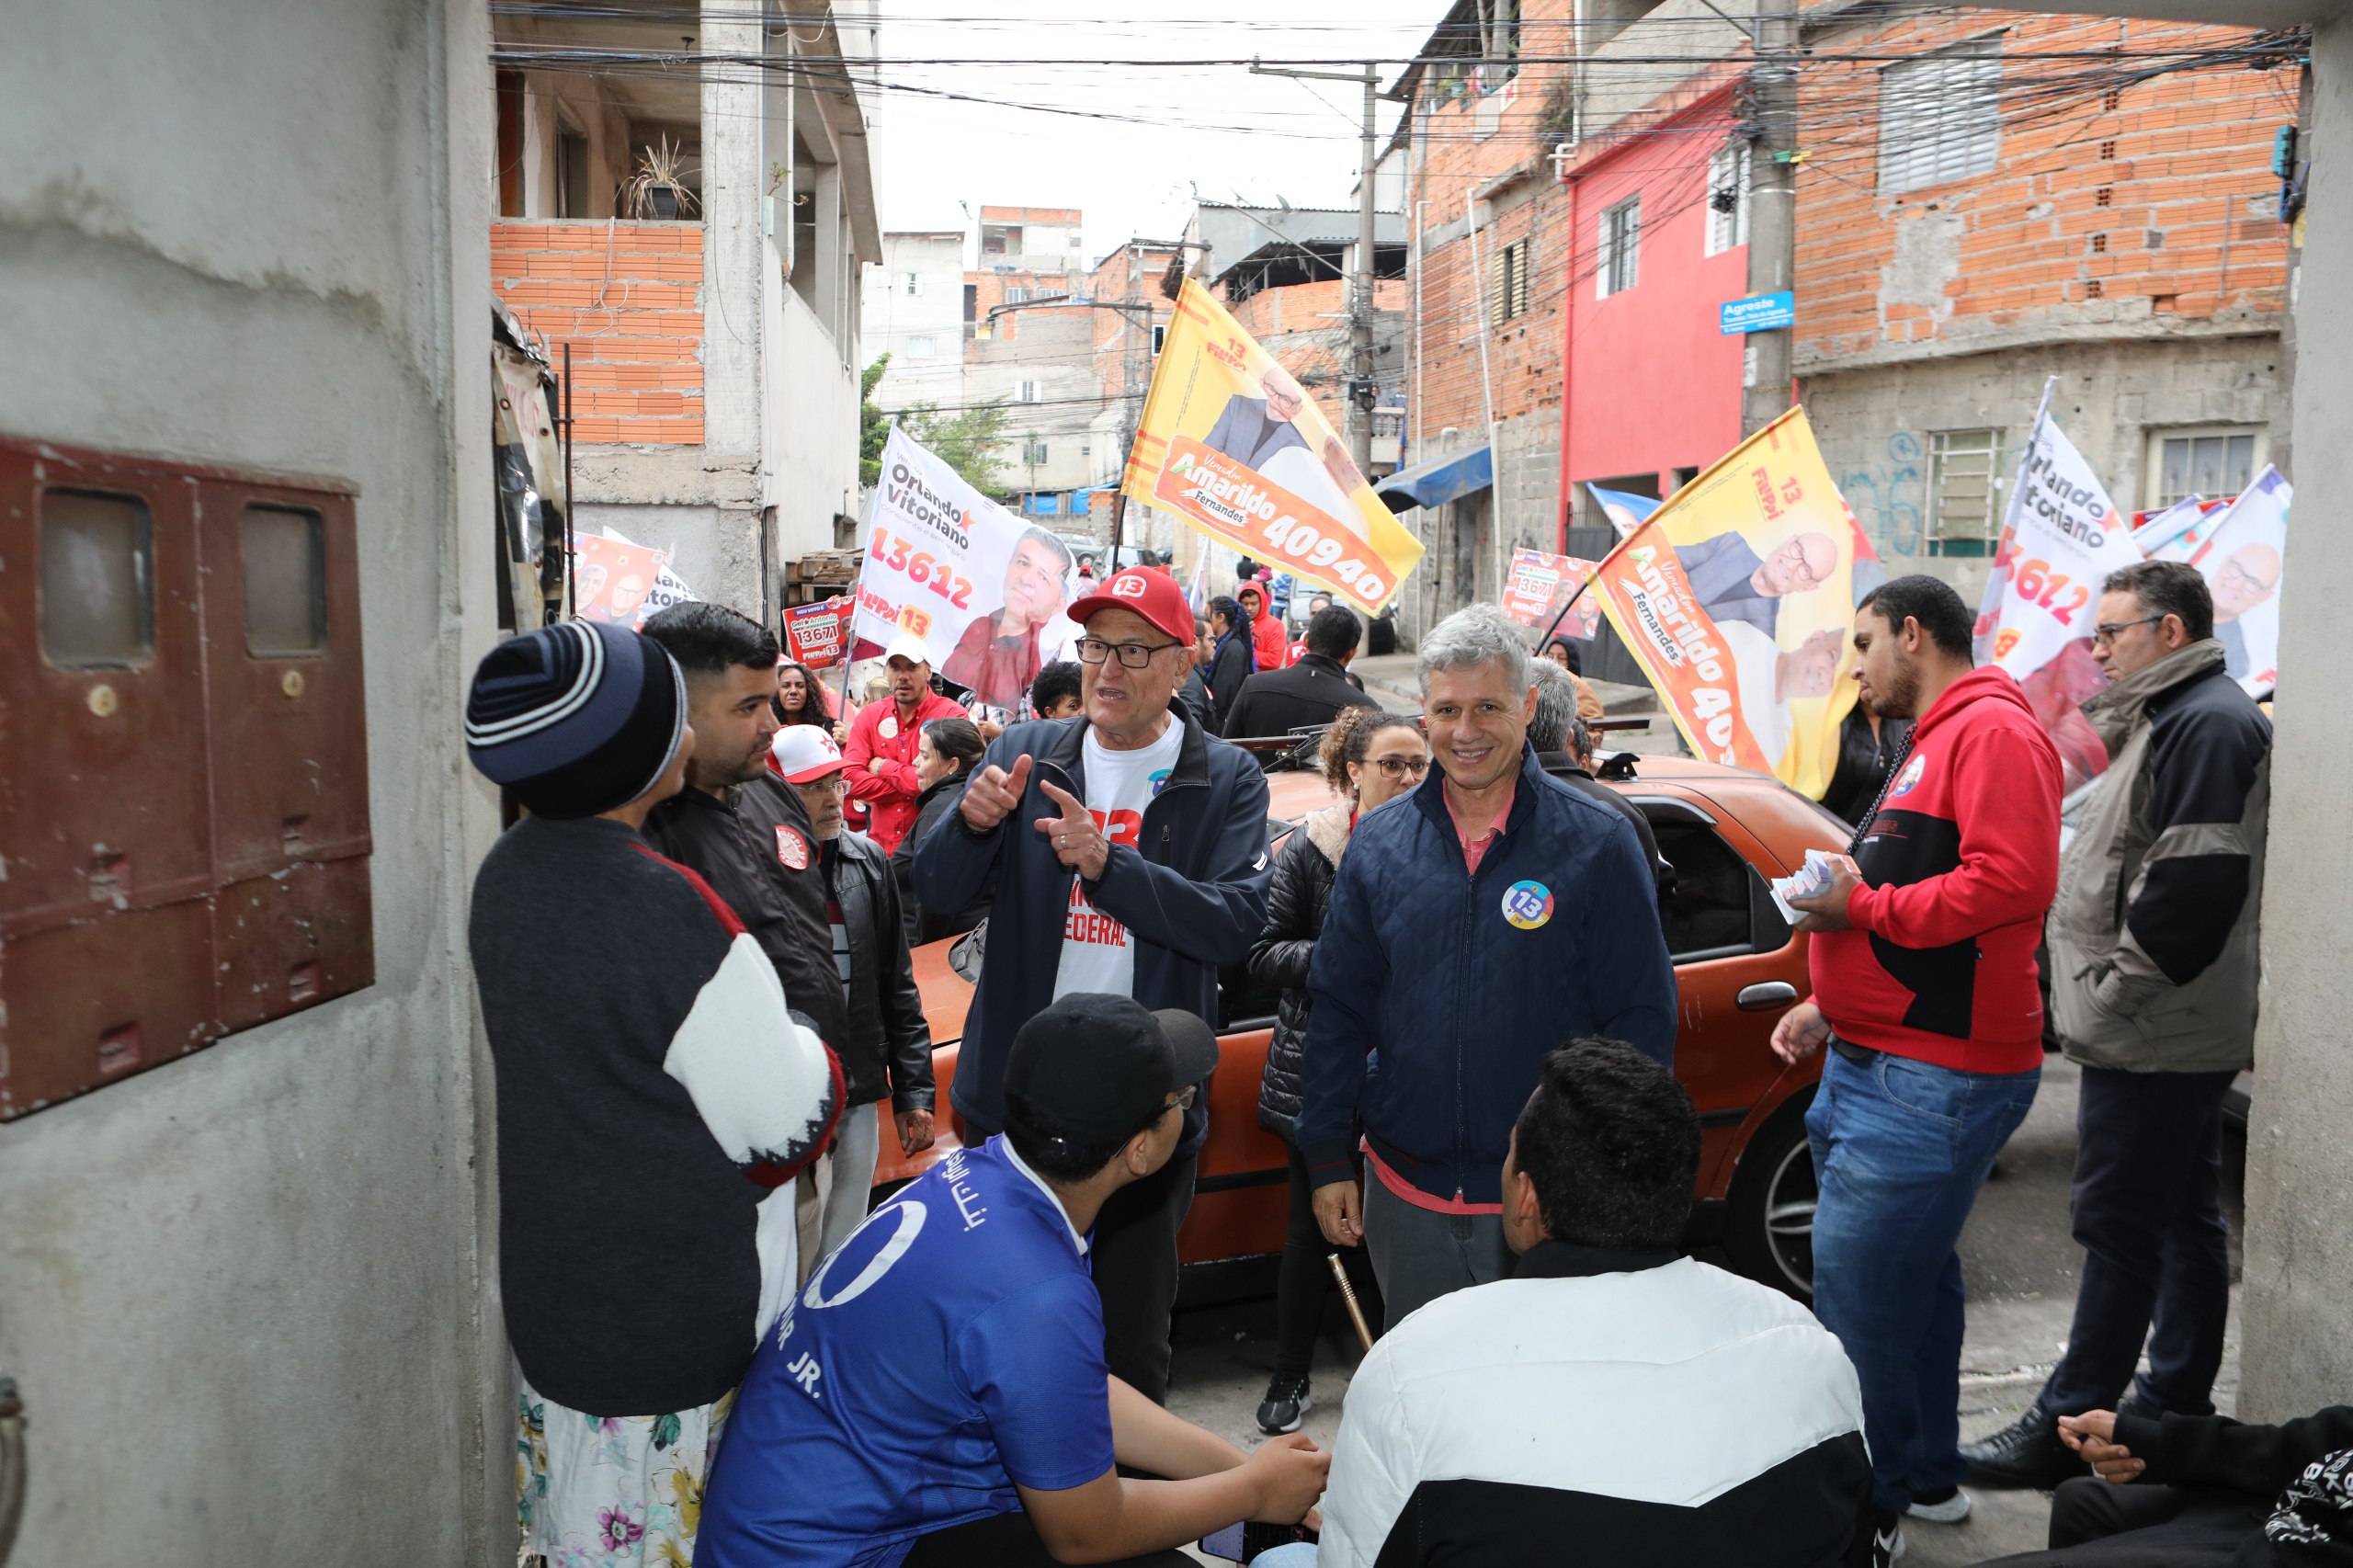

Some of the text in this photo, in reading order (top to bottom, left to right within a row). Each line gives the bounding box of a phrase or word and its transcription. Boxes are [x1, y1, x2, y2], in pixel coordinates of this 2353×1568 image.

[1723, 298, 1776, 316] Agreste
[1227, 337, 1246, 359] 13
[892, 463, 961, 523] Orlando
[1168, 452, 1277, 521] Amarildo
[1779, 476, 1802, 505] 13
[888, 483, 969, 550] Vitoriano
[1194, 490, 1245, 523] Fernandes
[870, 527, 972, 610] 13612
[1262, 514, 1385, 600] 40940
[1117, 578, 1144, 595] 13
[1516, 576, 1552, 597] 13671
[791, 619, 804, 628] Gel
[810, 613, 837, 624] Antonio
[796, 608, 808, 616] MEU
[807, 606, 821, 614] VOTO
[904, 608, 928, 636] 13
[1627, 544, 1723, 683] Amarildo
[796, 625, 837, 644] 13671
[1632, 591, 1679, 662] Fernandes
[827, 645, 838, 654] 13
[1515, 891, 1543, 918] 13
[786, 1351, 822, 1399] JR.
